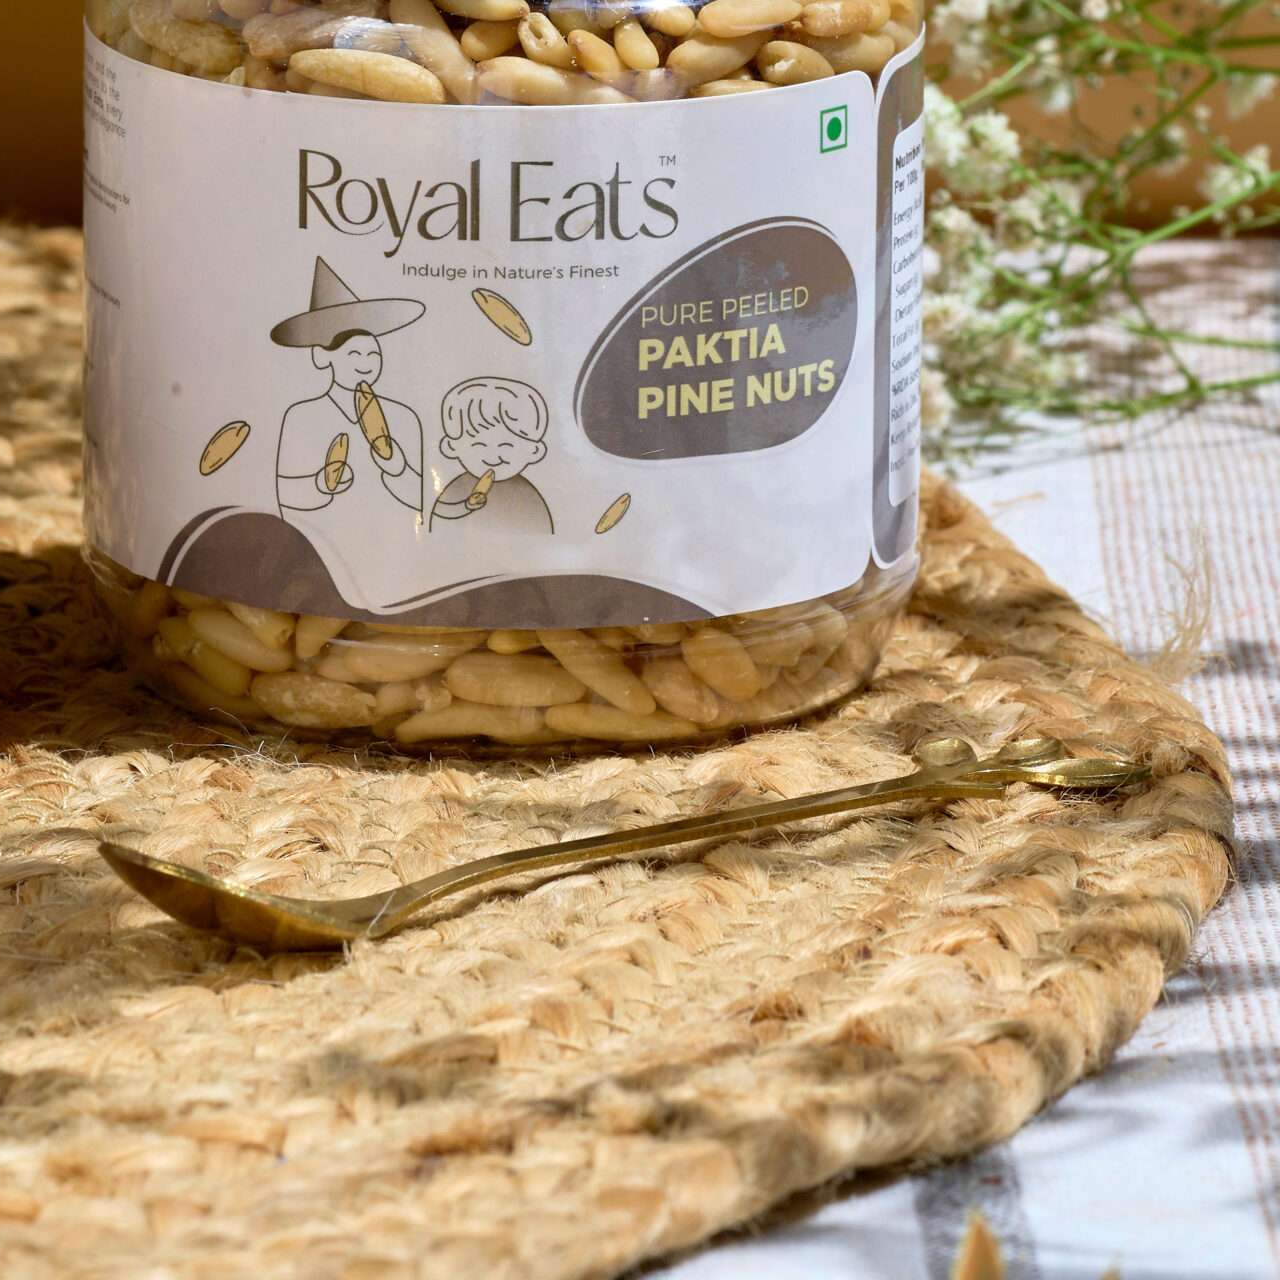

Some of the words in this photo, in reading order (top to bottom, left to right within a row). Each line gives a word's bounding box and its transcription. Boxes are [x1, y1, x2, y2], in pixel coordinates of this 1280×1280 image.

[107, 67, 117, 82] the
[110, 86, 120, 102] the
[894, 179, 905, 195] Per
[299, 148, 481, 258] Royal
[510, 161, 679, 242] Eats
[402, 263, 467, 281] Indulge
[472, 265, 488, 279] in
[494, 266, 564, 279] Nature's
[570, 264, 619, 279] Finest
[641, 300, 713, 329] PURE
[722, 286, 809, 321] PEELED
[638, 323, 787, 371] PAKTIA
[638, 378, 735, 419] PINE
[746, 359, 836, 407] NUTS
